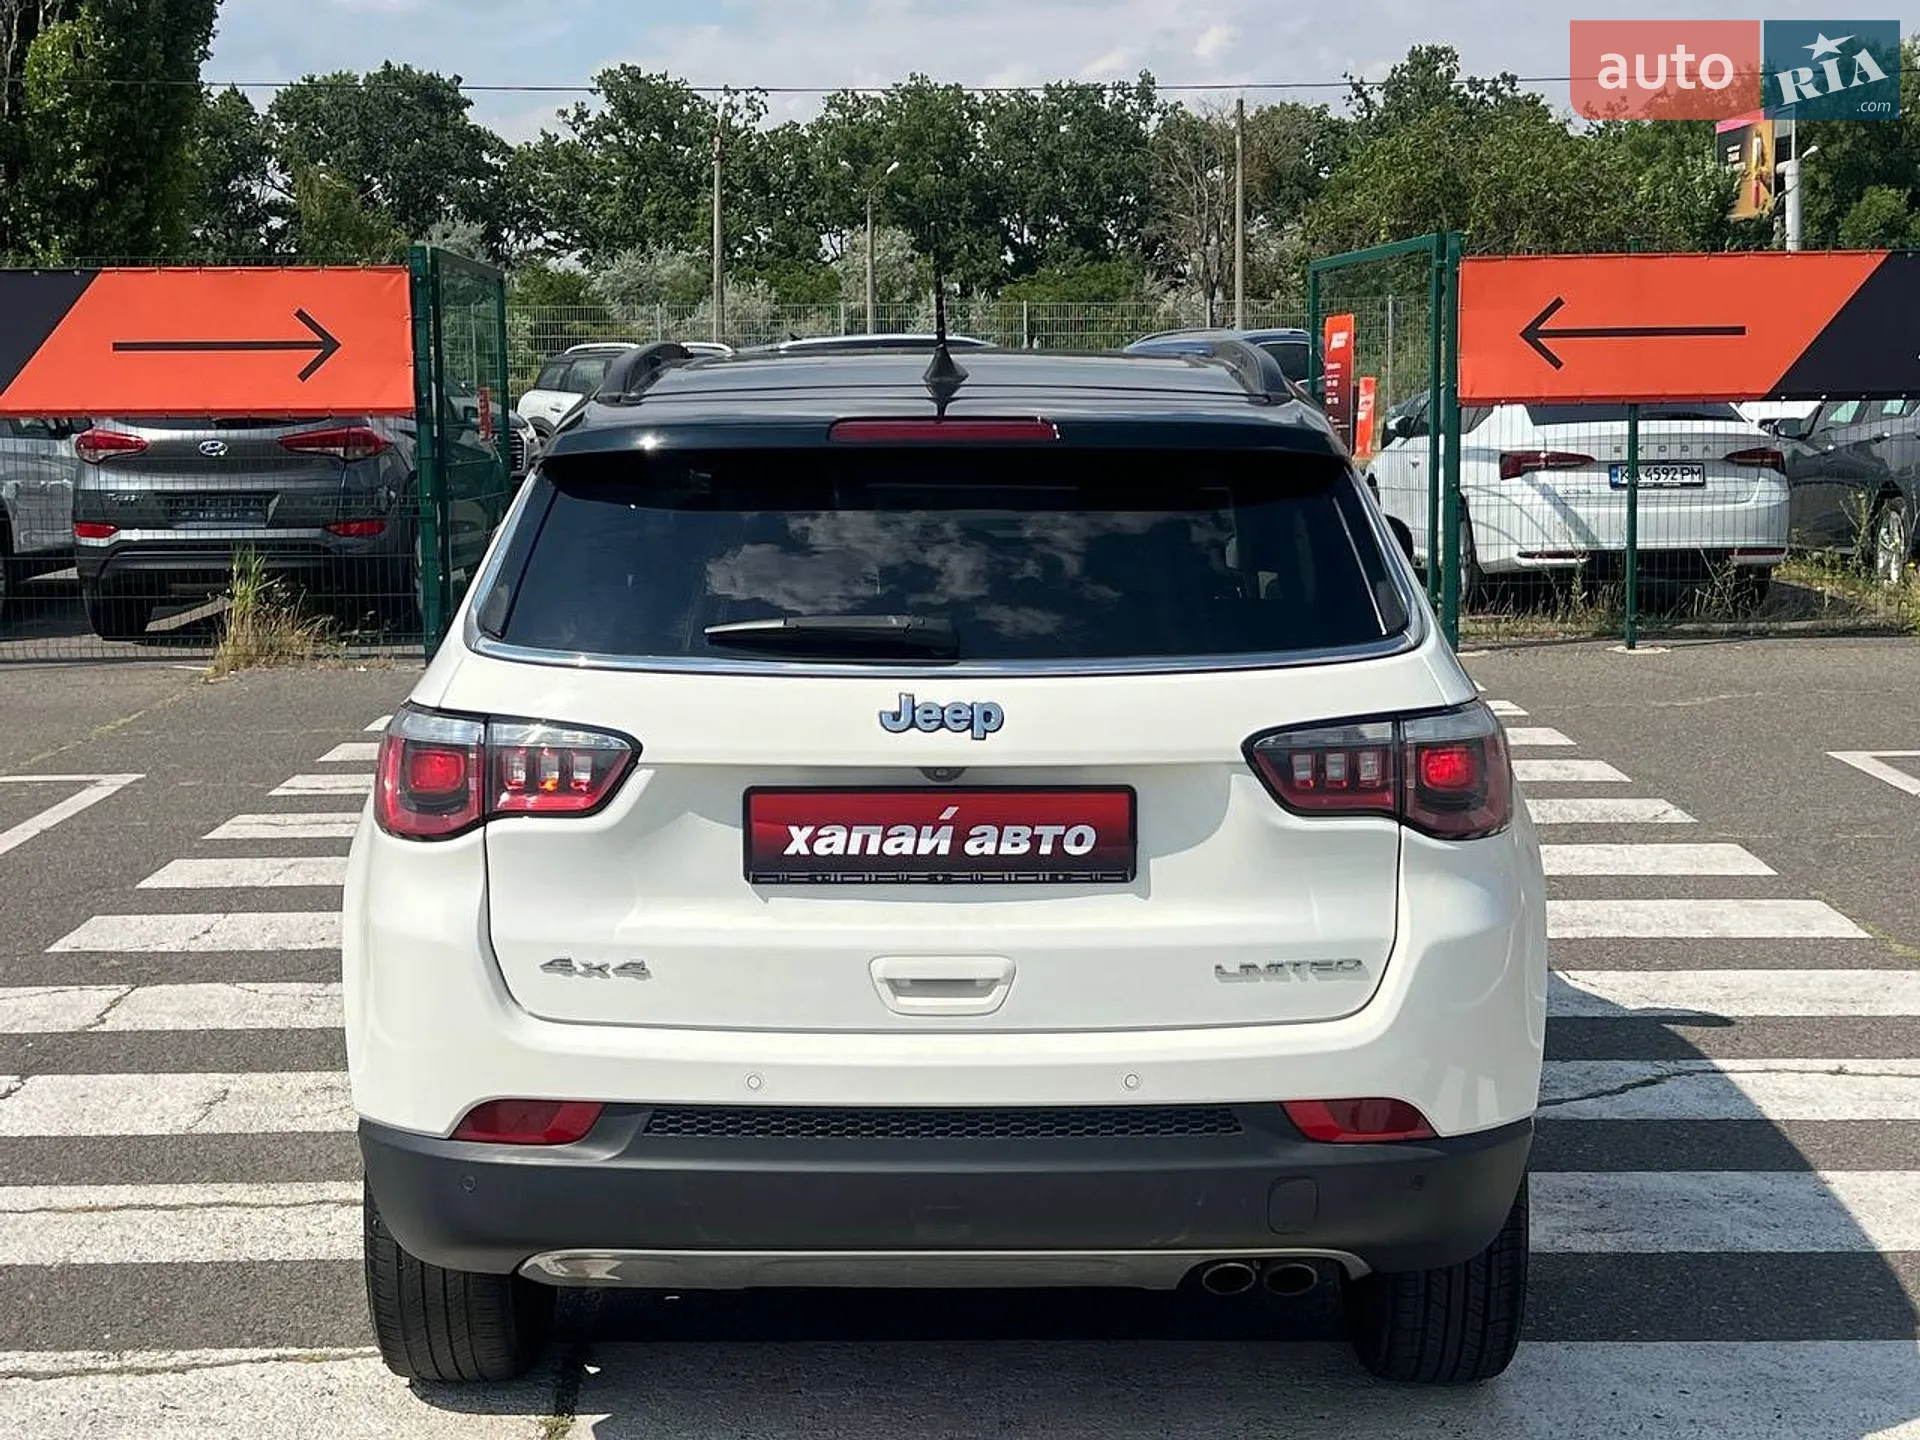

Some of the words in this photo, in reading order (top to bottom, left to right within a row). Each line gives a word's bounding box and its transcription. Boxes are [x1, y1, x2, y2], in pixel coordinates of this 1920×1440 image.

[1645, 467, 1678, 481] 4592
[879, 693, 1004, 740] Jeep
[964, 823, 1096, 856] авто
[540, 957, 653, 982] 4x4
[1214, 958, 1370, 983] LIMITED
